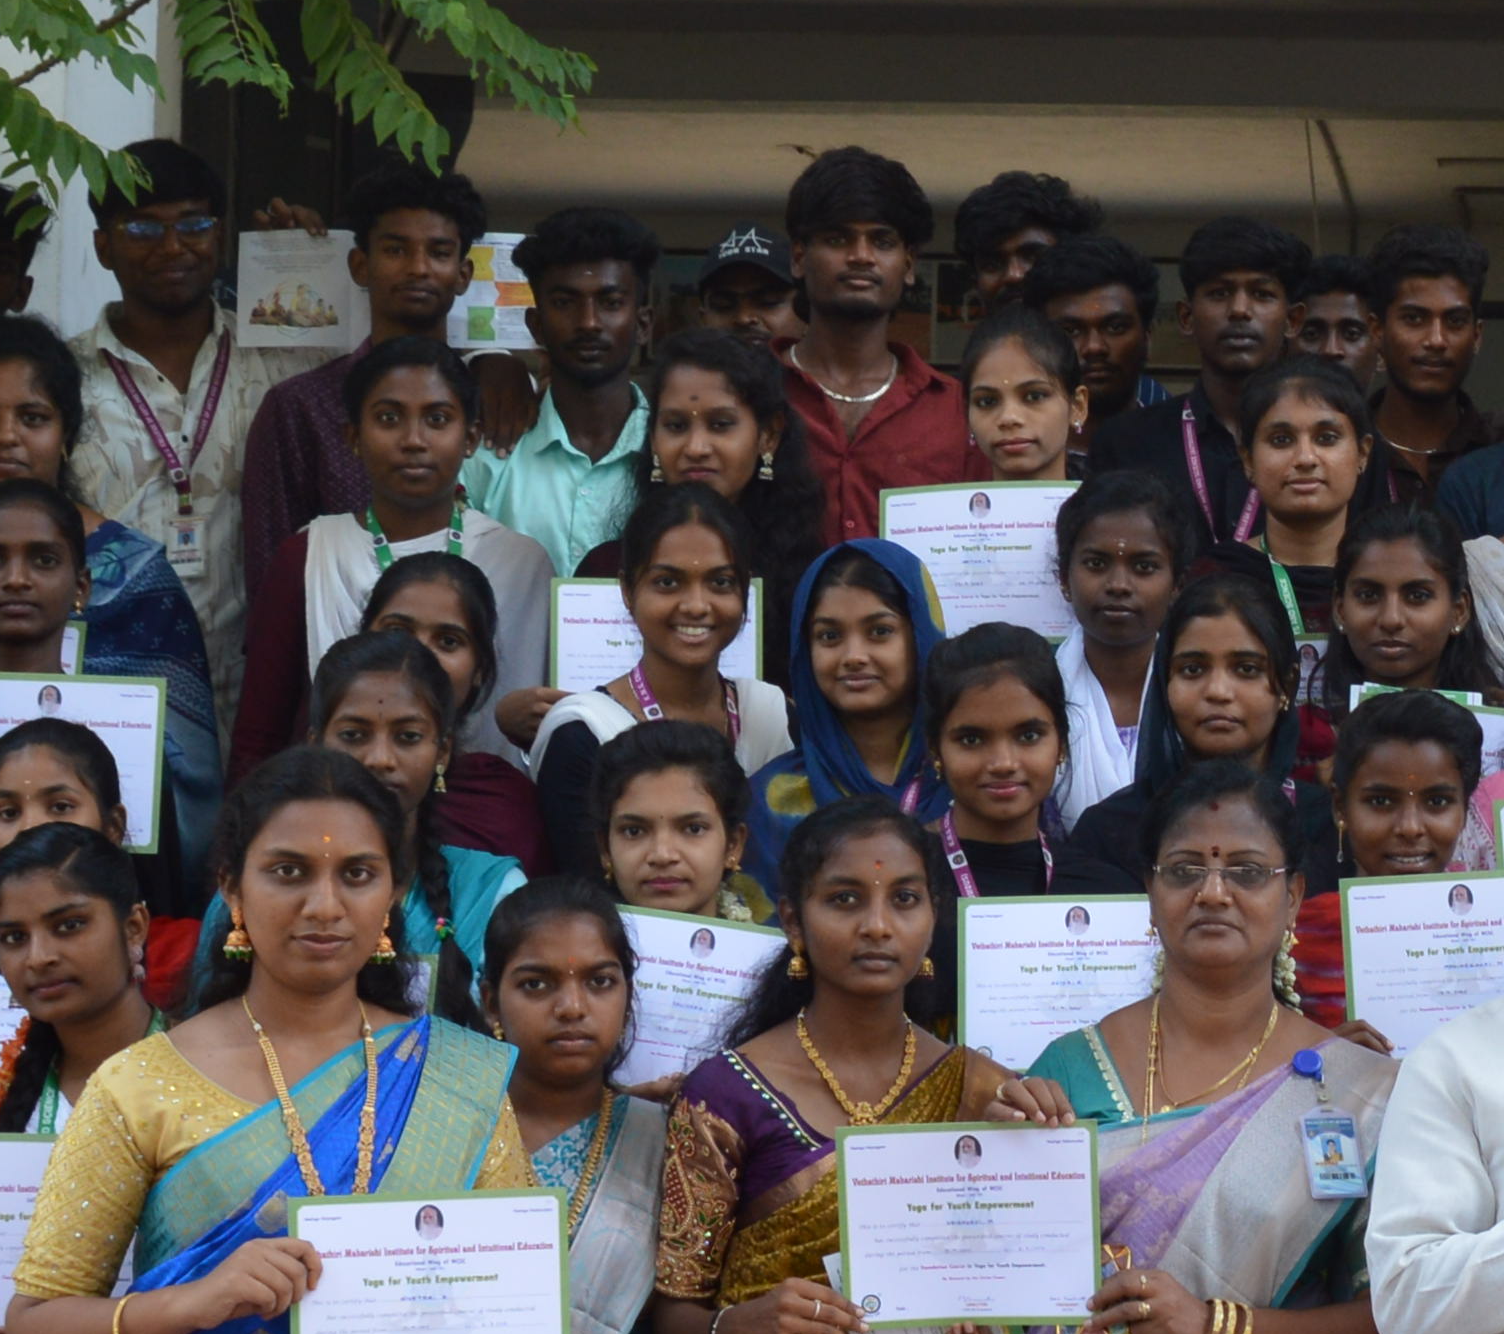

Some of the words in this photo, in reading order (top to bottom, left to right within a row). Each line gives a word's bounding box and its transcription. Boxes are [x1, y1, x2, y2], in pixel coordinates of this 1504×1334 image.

[1406, 949, 1424, 958] Yoga
[1428, 948, 1439, 956] for
[1443, 947, 1464, 955] Youth
[1021, 966, 1039, 974] Yoga
[1083, 964, 1136, 972] Empowerment
[907, 1203, 927, 1213] Yoga
[931, 1203, 943, 1211] for
[975, 1201, 1034, 1211] Empowerment
[363, 1278, 384, 1288] Yoga
[389, 1277, 401, 1286] for
[406, 1276, 431, 1285] Youth
[436, 1274, 498, 1285] Empowerment
